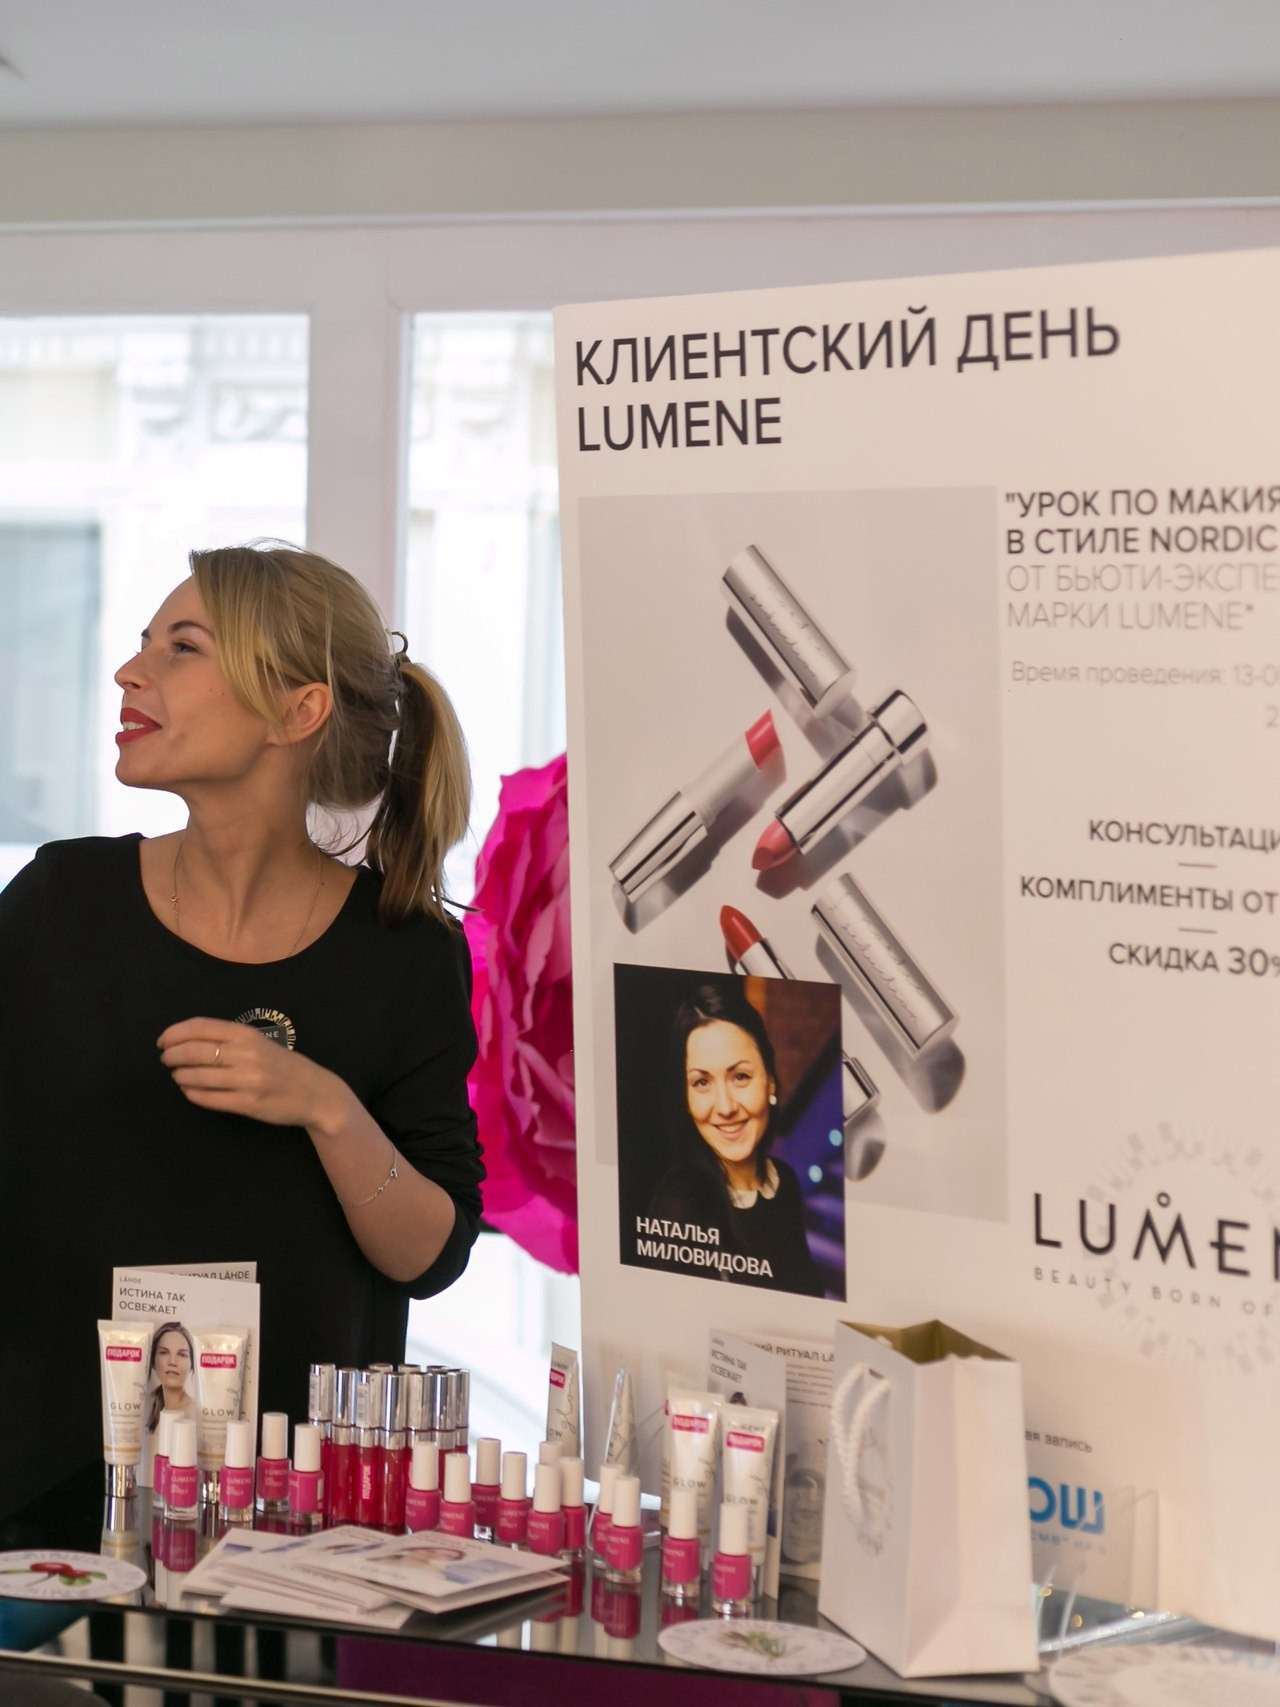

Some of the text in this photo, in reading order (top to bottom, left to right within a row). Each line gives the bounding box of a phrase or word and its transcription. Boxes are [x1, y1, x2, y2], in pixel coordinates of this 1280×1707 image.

[576, 304, 1121, 386] КЛИЕНТСКИЙ ДЕНЬ
[577, 397, 782, 451] LUMENE
[1005, 490, 1101, 518] "УРОК
[1111, 489, 1158, 515] ПО
[1007, 524, 1279, 554] В СТИЛЕ NORDIC
[1007, 562, 1280, 592] ОТ БЬЮТИ-ЭКСПЕ
[1007, 602, 1109, 629] МАРКИ
[1012, 661, 1079, 685] Время
[1020, 876, 1279, 914] КОМПЛИМЕНТЫ ОТ
[1109, 943, 1220, 973] СКИДКА
[636, 1216, 720, 1245] НАТАЛЬЯ
[1034, 1192, 1280, 1282] LUME
[636, 1239, 773, 1278] МИЛОВИДОВА
[120, 1287, 186, 1303] ИСТИНА ТАК
[1034, 1266, 1132, 1295] BEAUTY
[1152, 1286, 1221, 1308] BORN
[119, 1300, 177, 1315] ОСВЕЖАЕТ
[201, 1355, 235, 1365] ПОДАРОК
[776, 1346, 819, 1361] РИТУАЛ
[110, 1402, 142, 1410] GLOW
[202, 1408, 235, 1417] GLOW
[1045, 1434, 1093, 1453] запись
